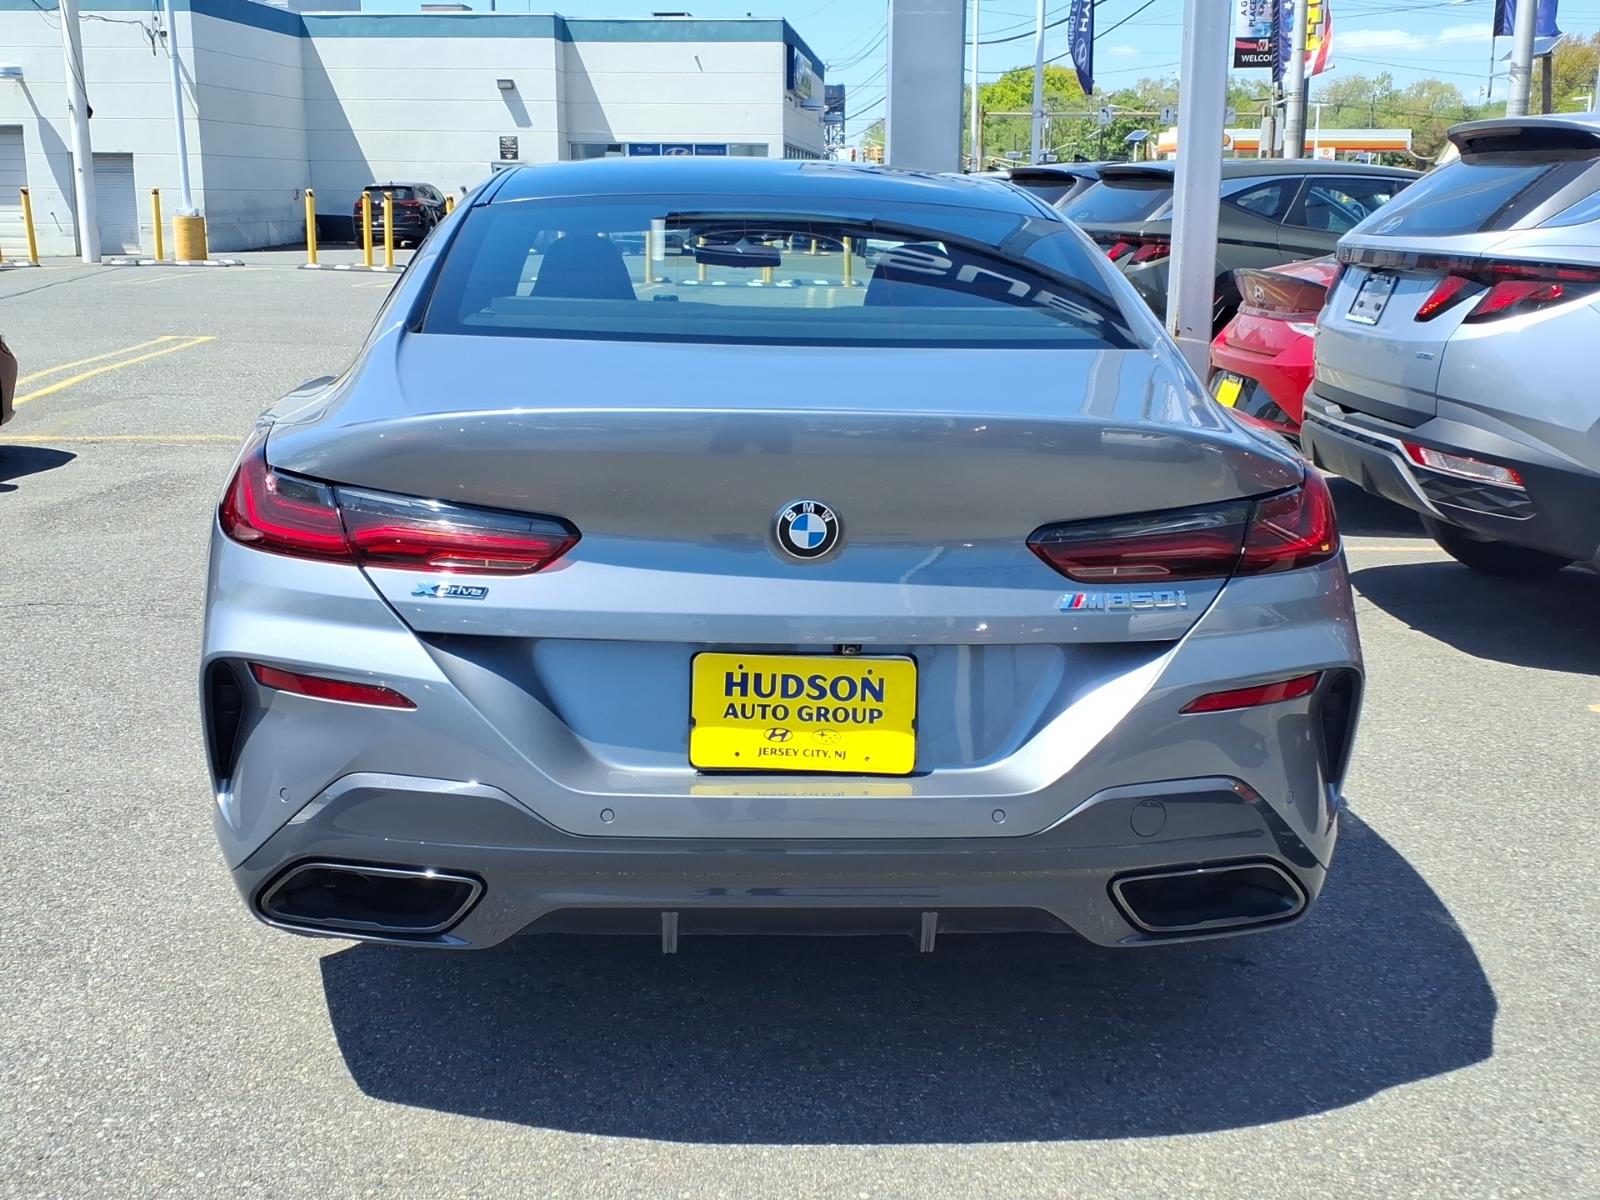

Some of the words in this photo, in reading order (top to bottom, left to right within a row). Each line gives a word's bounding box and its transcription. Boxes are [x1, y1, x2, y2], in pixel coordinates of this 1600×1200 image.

[784, 502, 834, 523] BMW
[724, 671, 885, 703] HUDSON
[723, 702, 790, 721] AUTO
[797, 705, 884, 724] GROUP
[758, 747, 799, 758] JERSEY
[802, 749, 831, 759] CITY,
[834, 750, 847, 760] NJ
